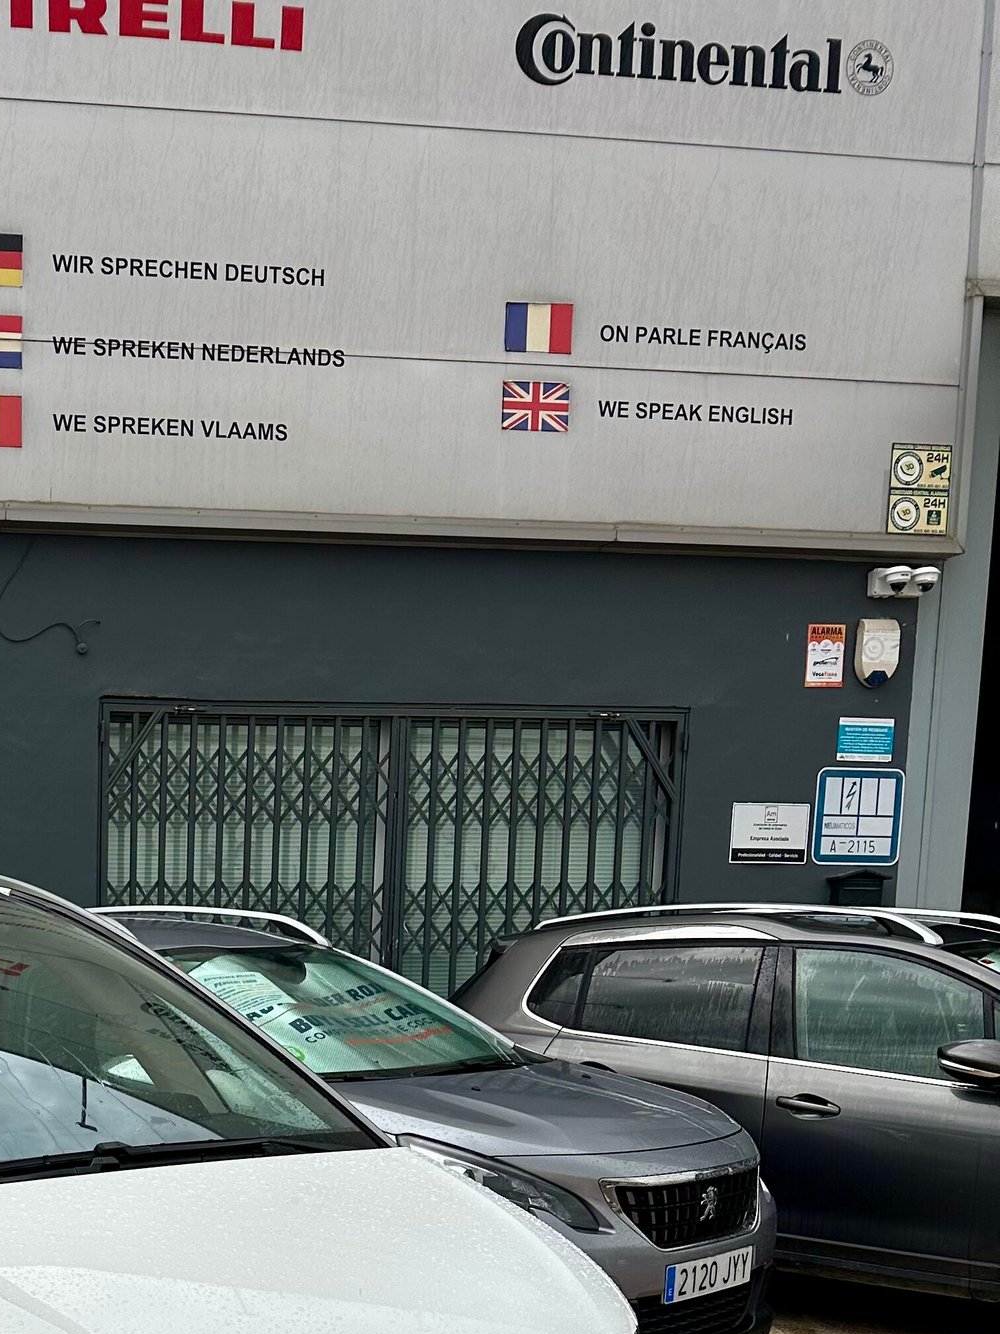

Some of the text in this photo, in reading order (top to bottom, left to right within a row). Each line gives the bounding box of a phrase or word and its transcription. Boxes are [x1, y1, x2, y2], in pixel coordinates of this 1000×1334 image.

[515, 12, 842, 94] Continental
[52, 254, 326, 287] WIR SPRECHEN DEUTSCH
[52, 336, 345, 368] WE SPREKEN NEDERLANDS
[599, 324, 807, 354] ON PARLE FRANÇAIS
[52, 414, 288, 442] WE SPREKEN VLAAMS
[598, 401, 794, 426] WE SPEAK ENGLISH
[927, 453, 949, 463] 24H
[923, 498, 946, 508] 24H
[811, 626, 843, 636] ALARMA
[678, 1261, 718, 1296] 2120
[723, 1251, 749, 1284] JYY
